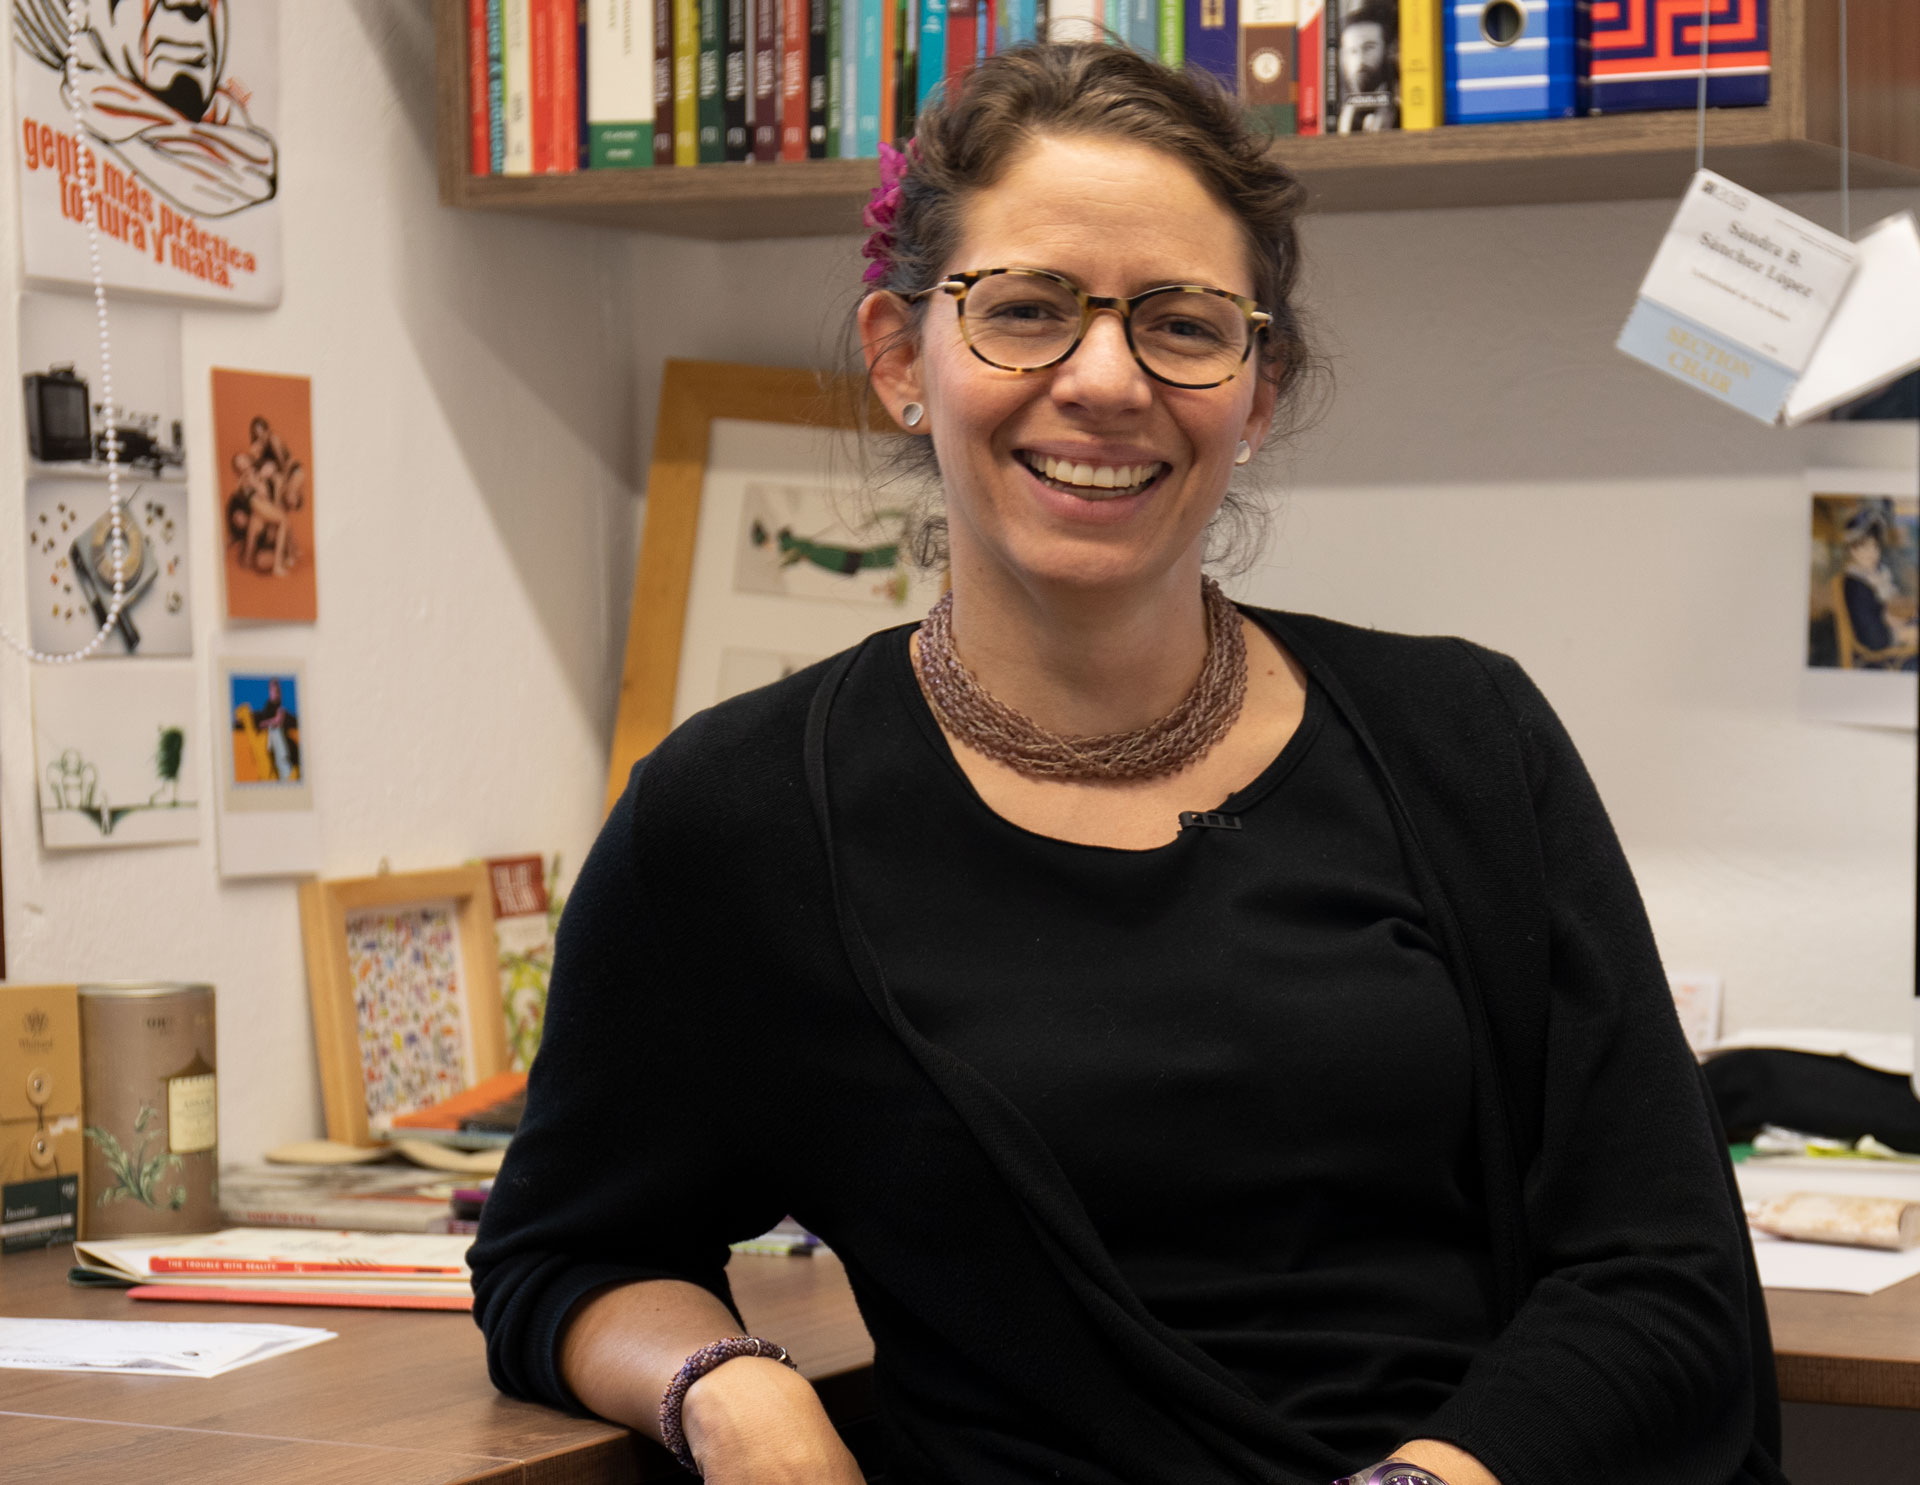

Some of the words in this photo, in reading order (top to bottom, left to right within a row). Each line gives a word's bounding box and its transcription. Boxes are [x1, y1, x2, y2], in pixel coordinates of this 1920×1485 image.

[23, 116, 97, 188] gente
[102, 160, 154, 222] más
[159, 202, 257, 273] práctica
[170, 239, 235, 289] mata.
[1699, 231, 1764, 274] Sánchez
[1728, 220, 1783, 258] Sandra
[1786, 250, 1802, 267] B.
[1666, 326, 1751, 379] SECTION
[1667, 352, 1732, 395] CHAIR
[168, 1260, 182, 1268] THE
[186, 1260, 219, 1269] TROUBLE
[223, 1261, 242, 1270] WITH
[245, 1262, 277, 1271] REALITY
